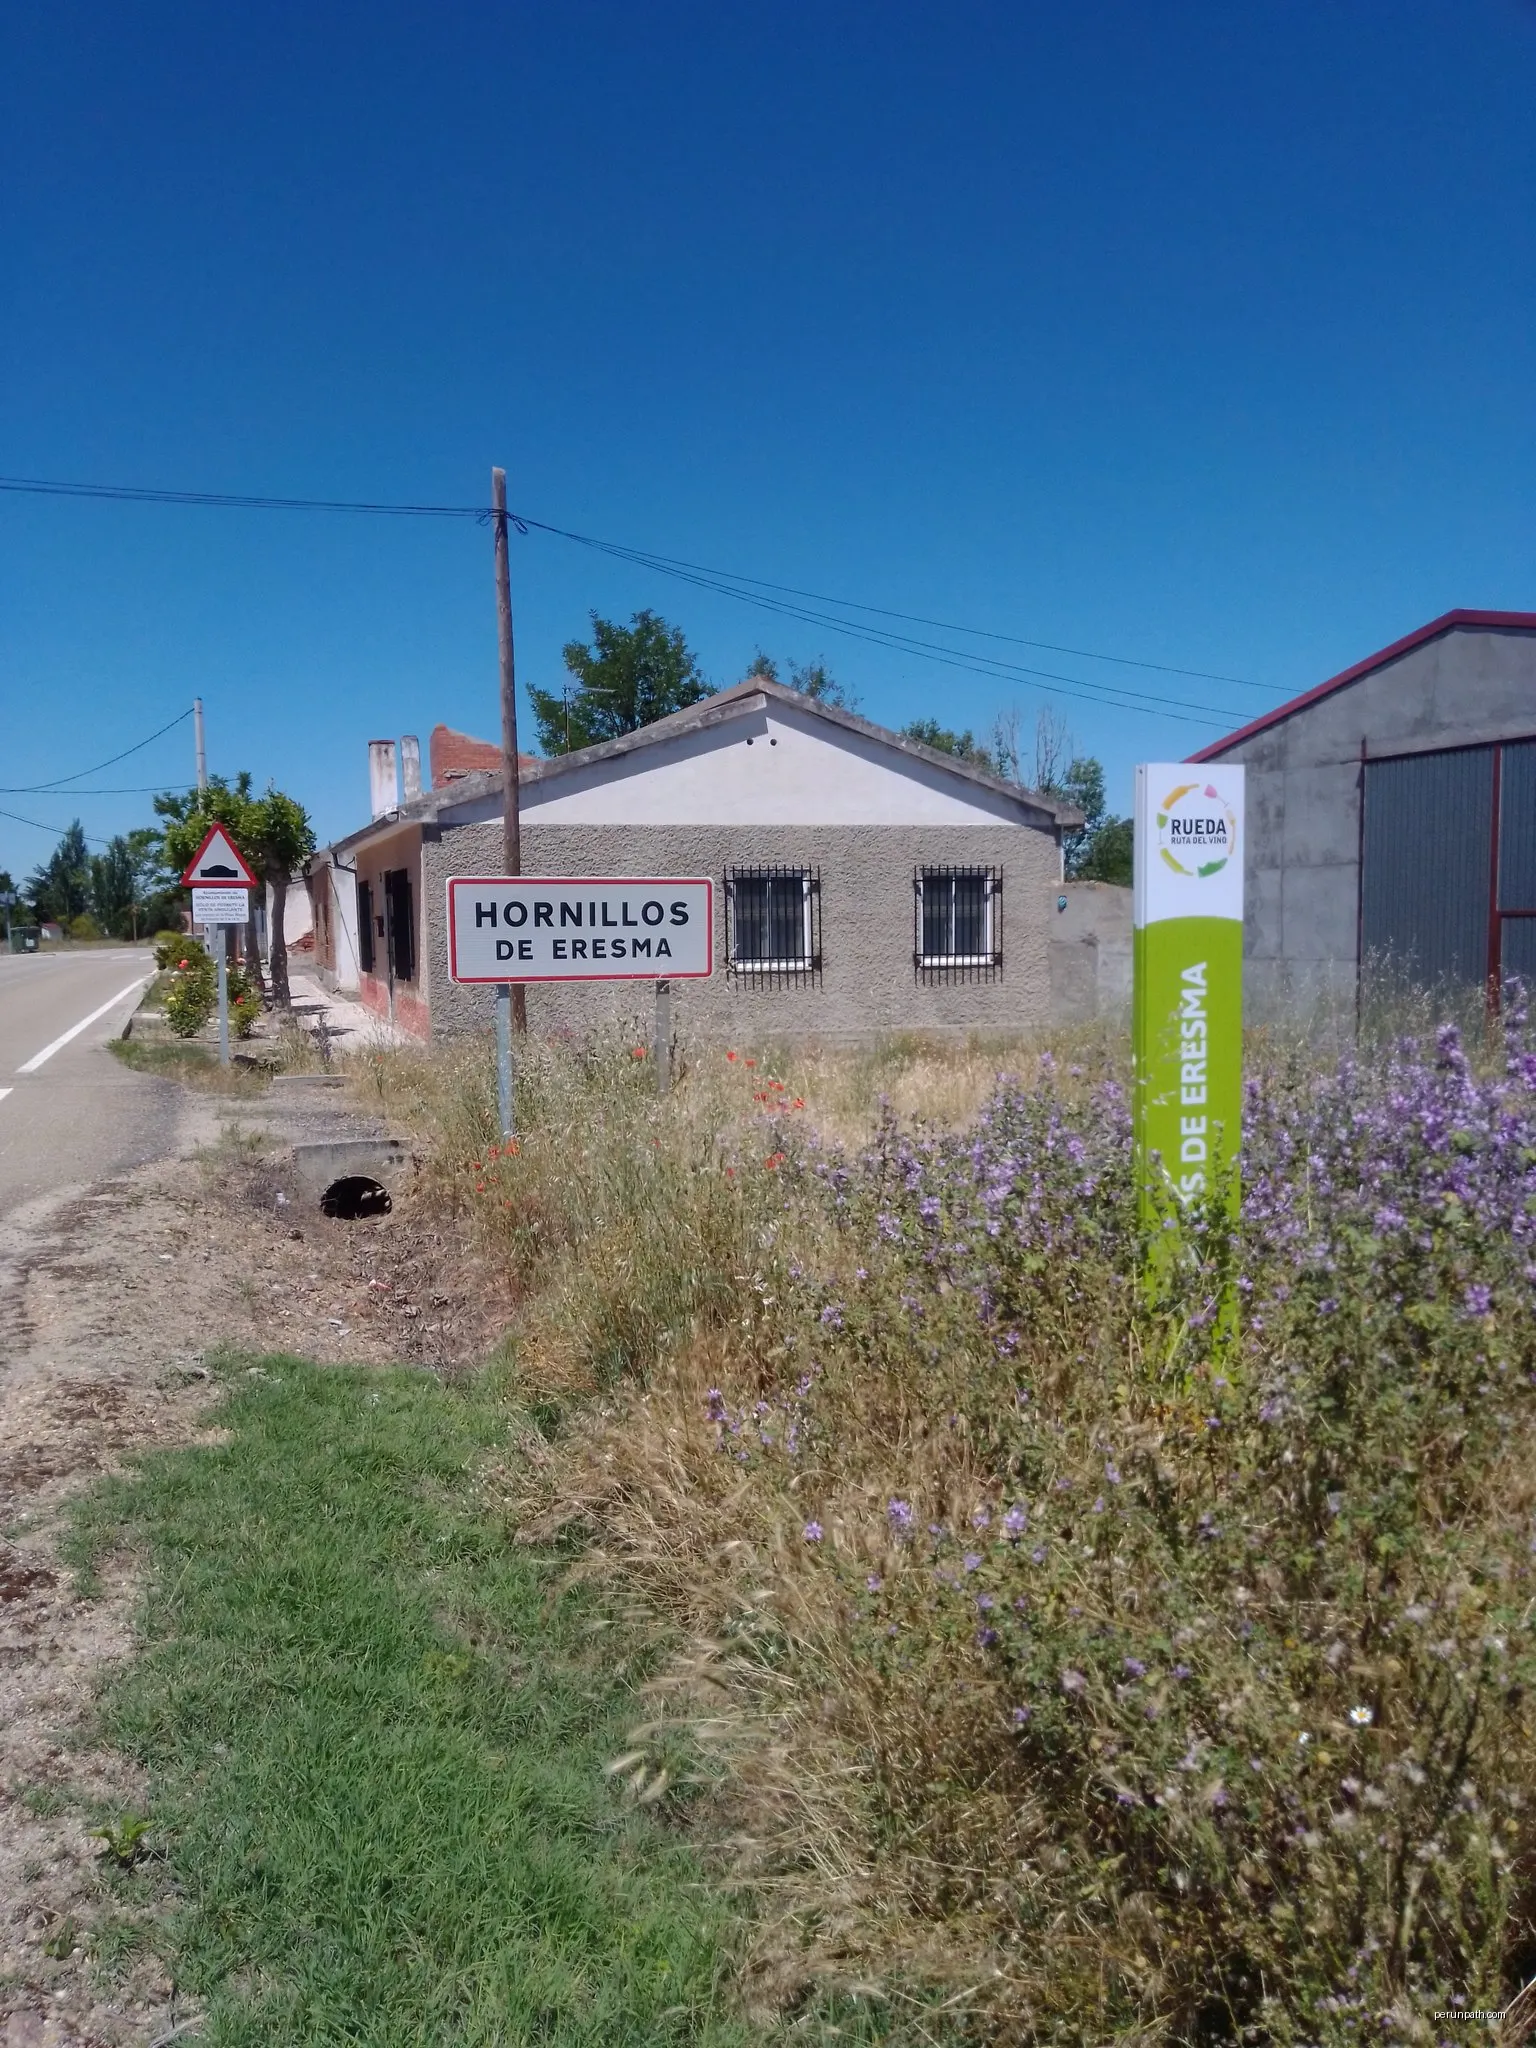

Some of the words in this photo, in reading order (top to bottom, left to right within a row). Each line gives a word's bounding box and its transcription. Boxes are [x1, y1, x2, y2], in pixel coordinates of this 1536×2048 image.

[1171, 819, 1226, 835] RUEDA
[1171, 836, 1191, 845] RUTA
[1192, 836, 1207, 844] DEL
[1209, 836, 1227, 844] VINO
[475, 900, 689, 928] HORNILLOS
[496, 939, 534, 960] DE
[552, 938, 672, 960] ERESMA
[1181, 961, 1207, 1105] ERESMA
[1181, 1115, 1207, 1162] DE
